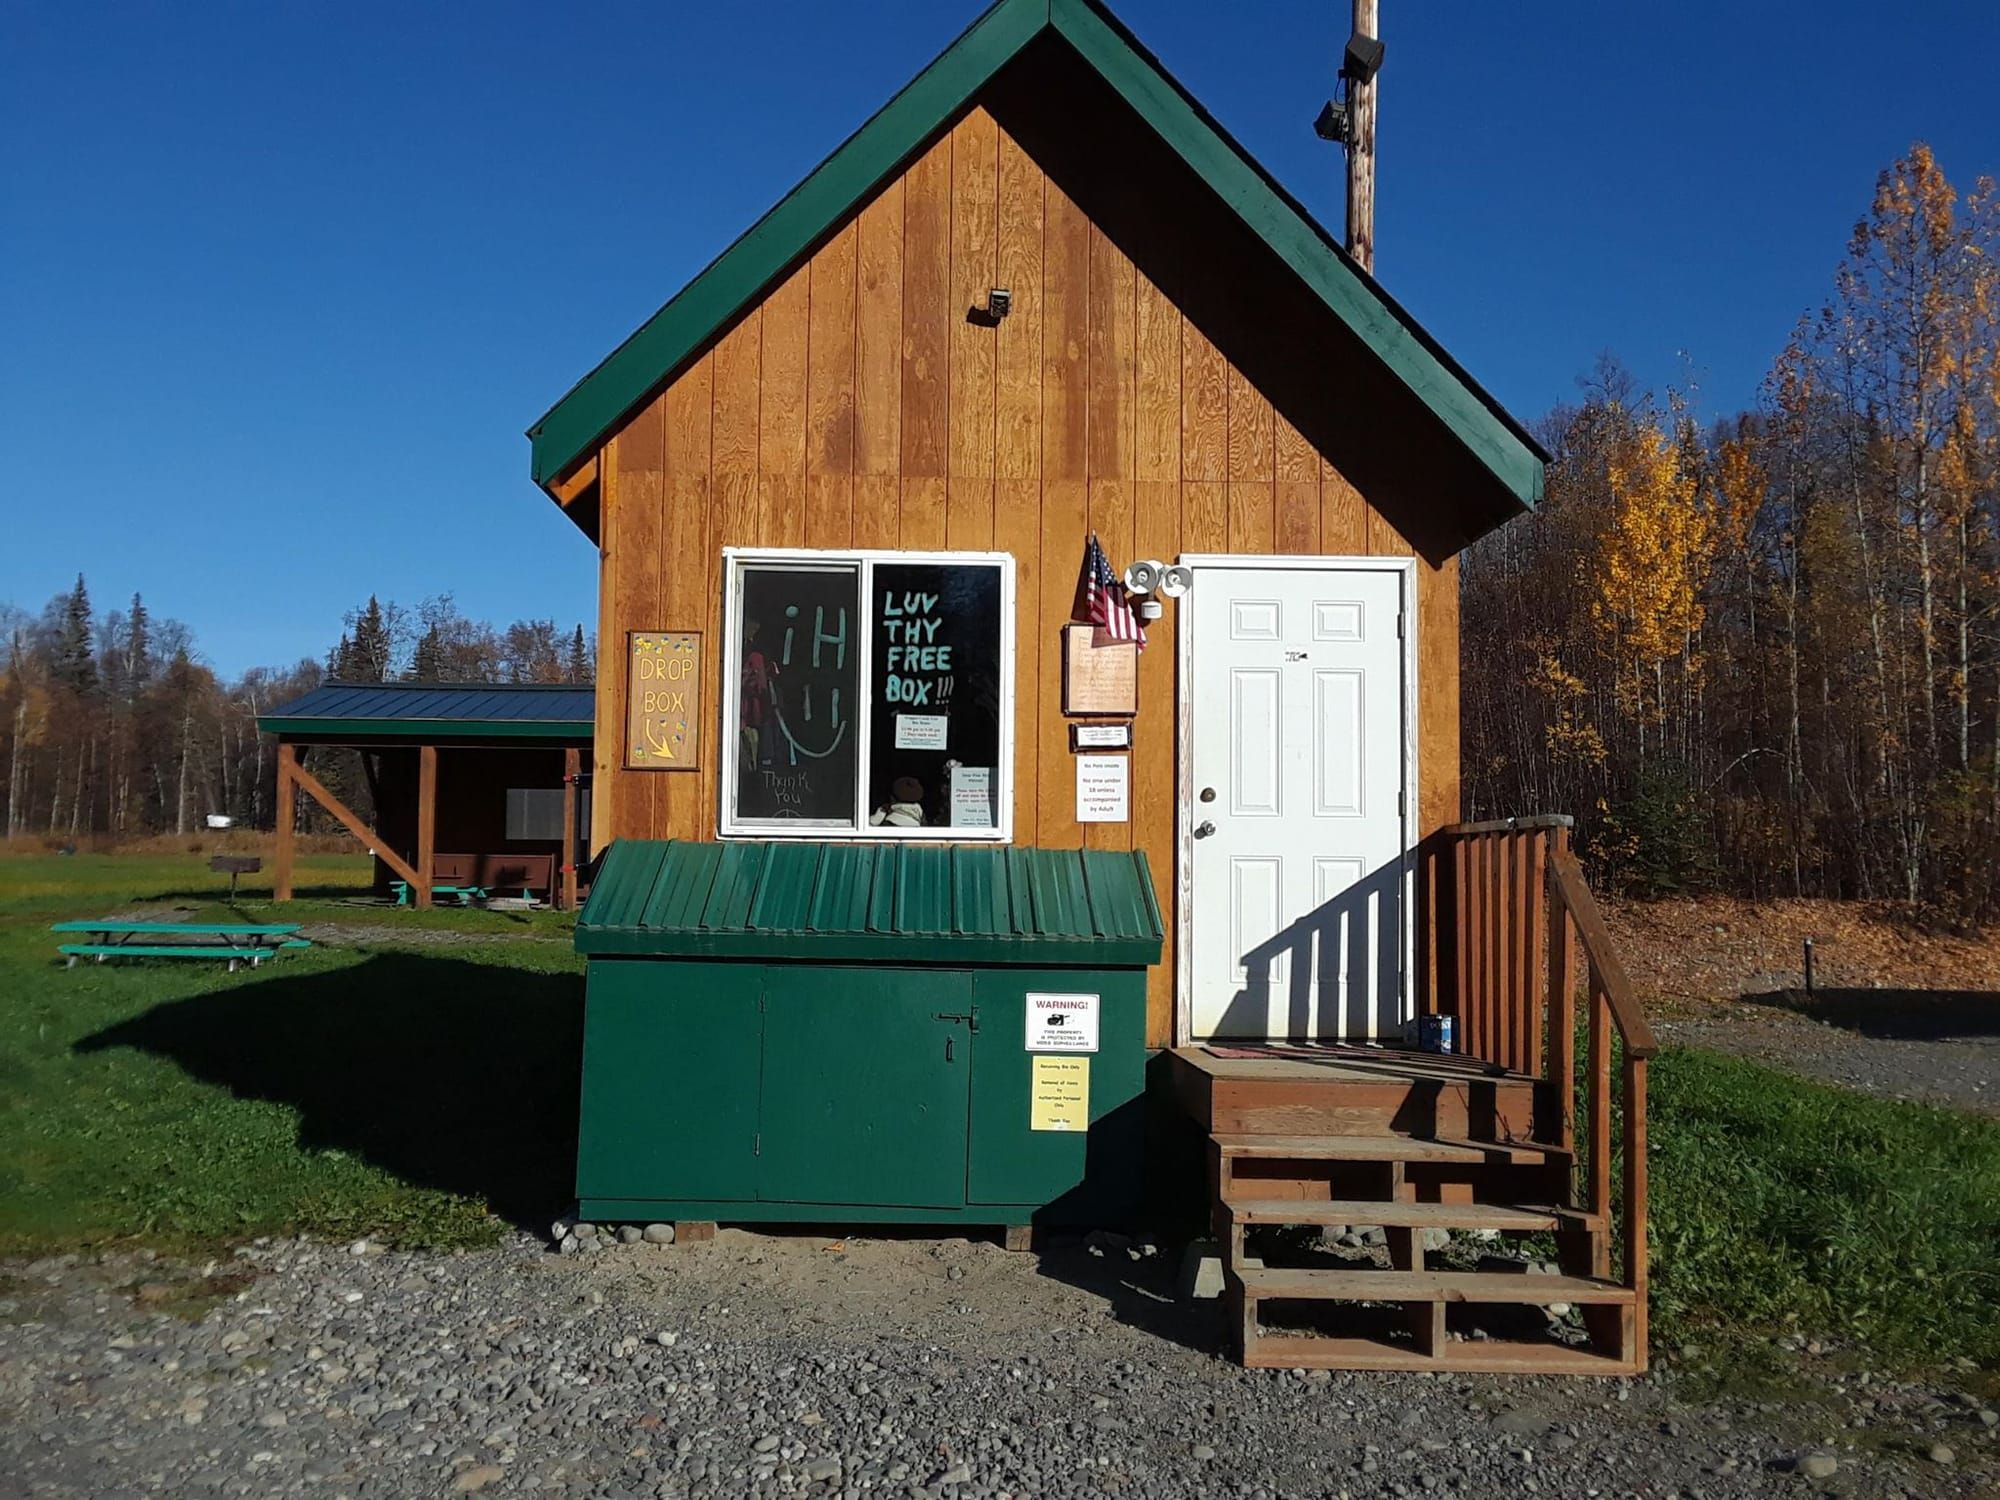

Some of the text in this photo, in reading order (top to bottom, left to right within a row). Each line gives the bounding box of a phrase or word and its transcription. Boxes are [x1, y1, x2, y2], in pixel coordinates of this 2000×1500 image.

[884, 591, 939, 616] LUV
[883, 617, 942, 644] THY
[640, 658, 694, 681] DROP
[887, 645, 953, 673] FREE
[644, 690, 685, 713] BOX
[1036, 1000, 1089, 1010] WARNING!
